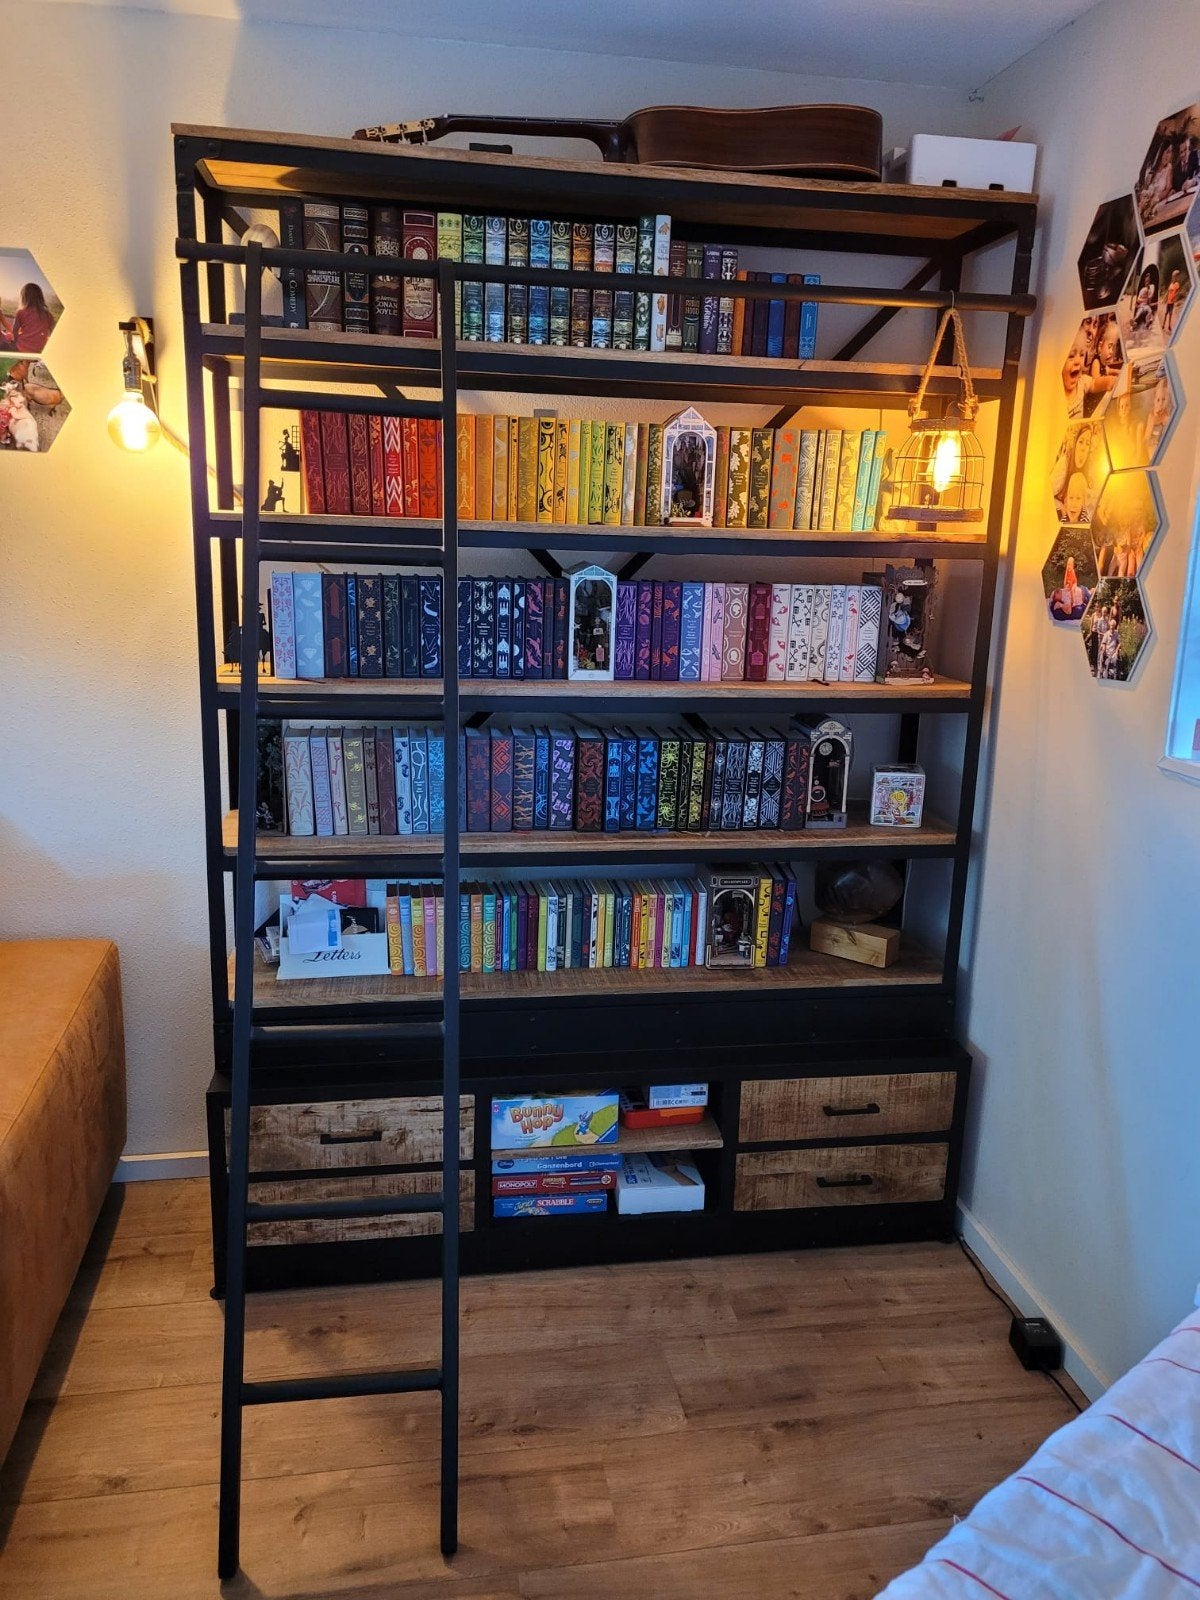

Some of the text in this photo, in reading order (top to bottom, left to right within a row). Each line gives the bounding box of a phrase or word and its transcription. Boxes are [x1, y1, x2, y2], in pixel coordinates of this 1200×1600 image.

[303, 947, 361, 963] Letters
[510, 1103, 565, 1123] Bunny
[521, 1116, 554, 1135] Hop
[499, 1181, 536, 1189] MONOPOLY
[536, 1198, 575, 1207] SCRABBLE
